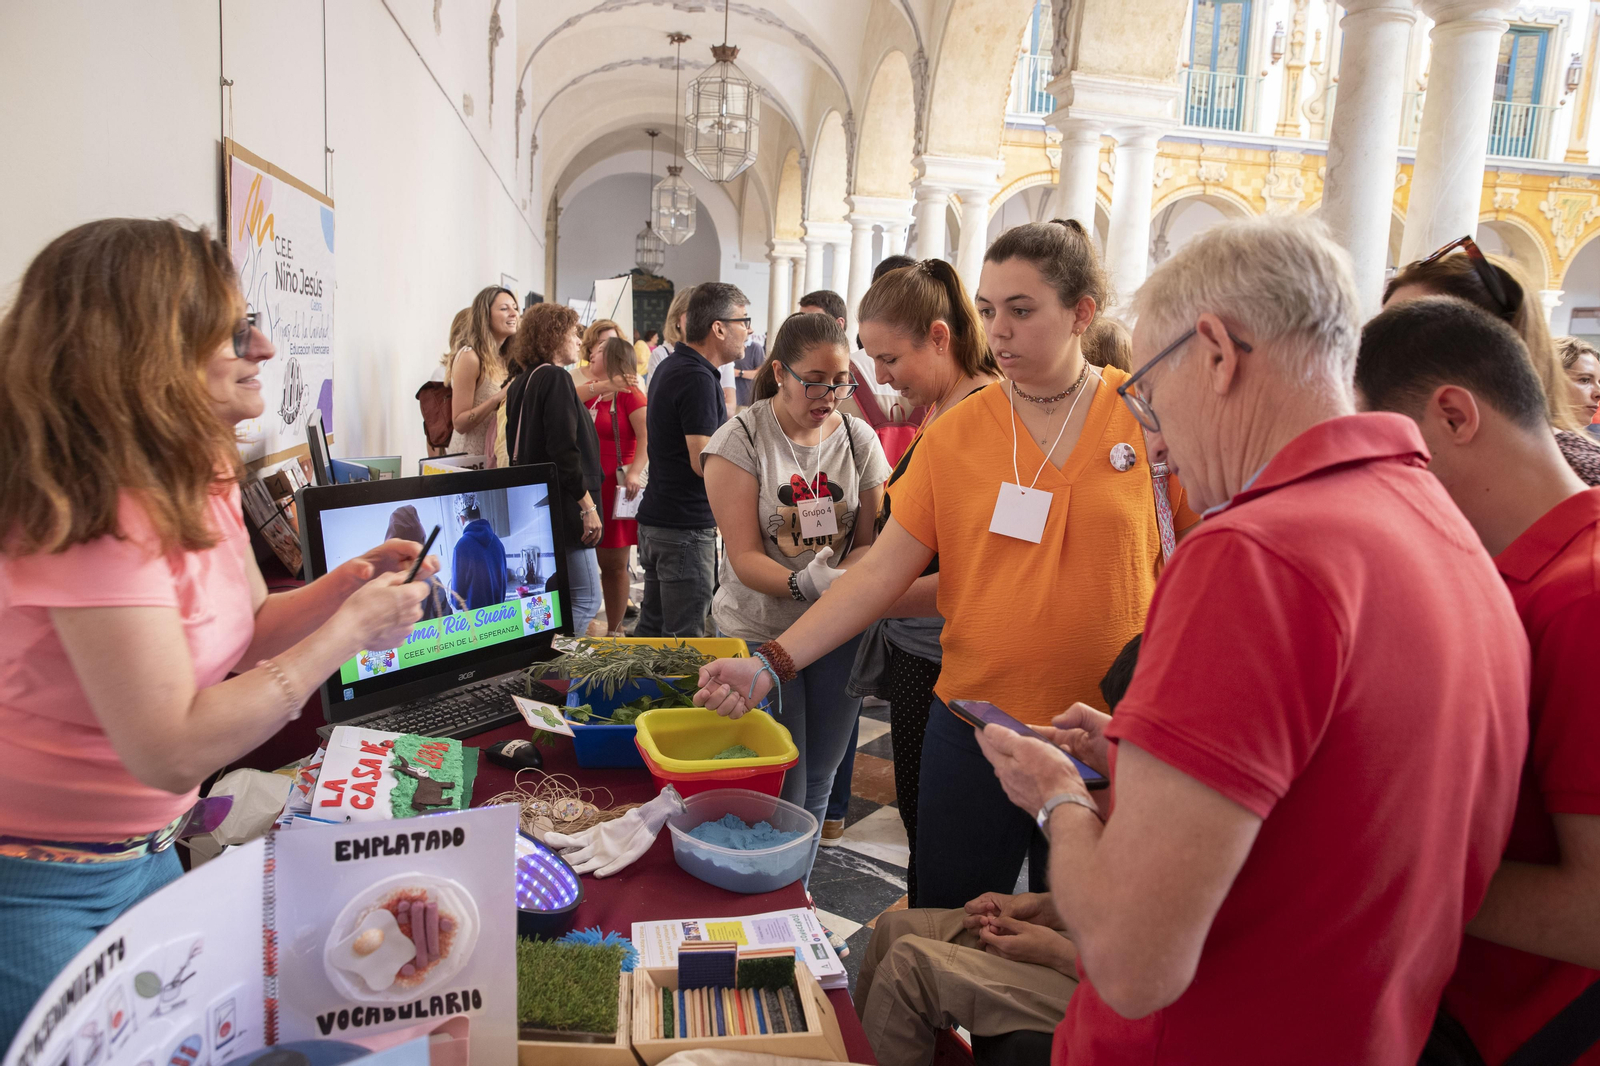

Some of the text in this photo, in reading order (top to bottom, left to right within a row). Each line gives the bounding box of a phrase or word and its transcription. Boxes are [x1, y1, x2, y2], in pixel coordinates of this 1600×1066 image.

[274, 235, 294, 259] C.E.E.
[275, 260, 323, 298] Niño Jesús
[802, 506, 832, 517] Grupo 4
[816, 520, 822, 528] A
[443, 614, 471, 636] Ríe,
[473, 605, 518, 629] Sueña
[403, 625, 520, 660] CEEE VIRGEN DE LA ESPERANZA
[457, 670, 476, 681] acer
[321, 779, 348, 807] LA
[350, 758, 383, 810] CASA
[334, 827, 465, 862] EMPLATADO
[316, 989, 482, 1036] VOCABULARIO
